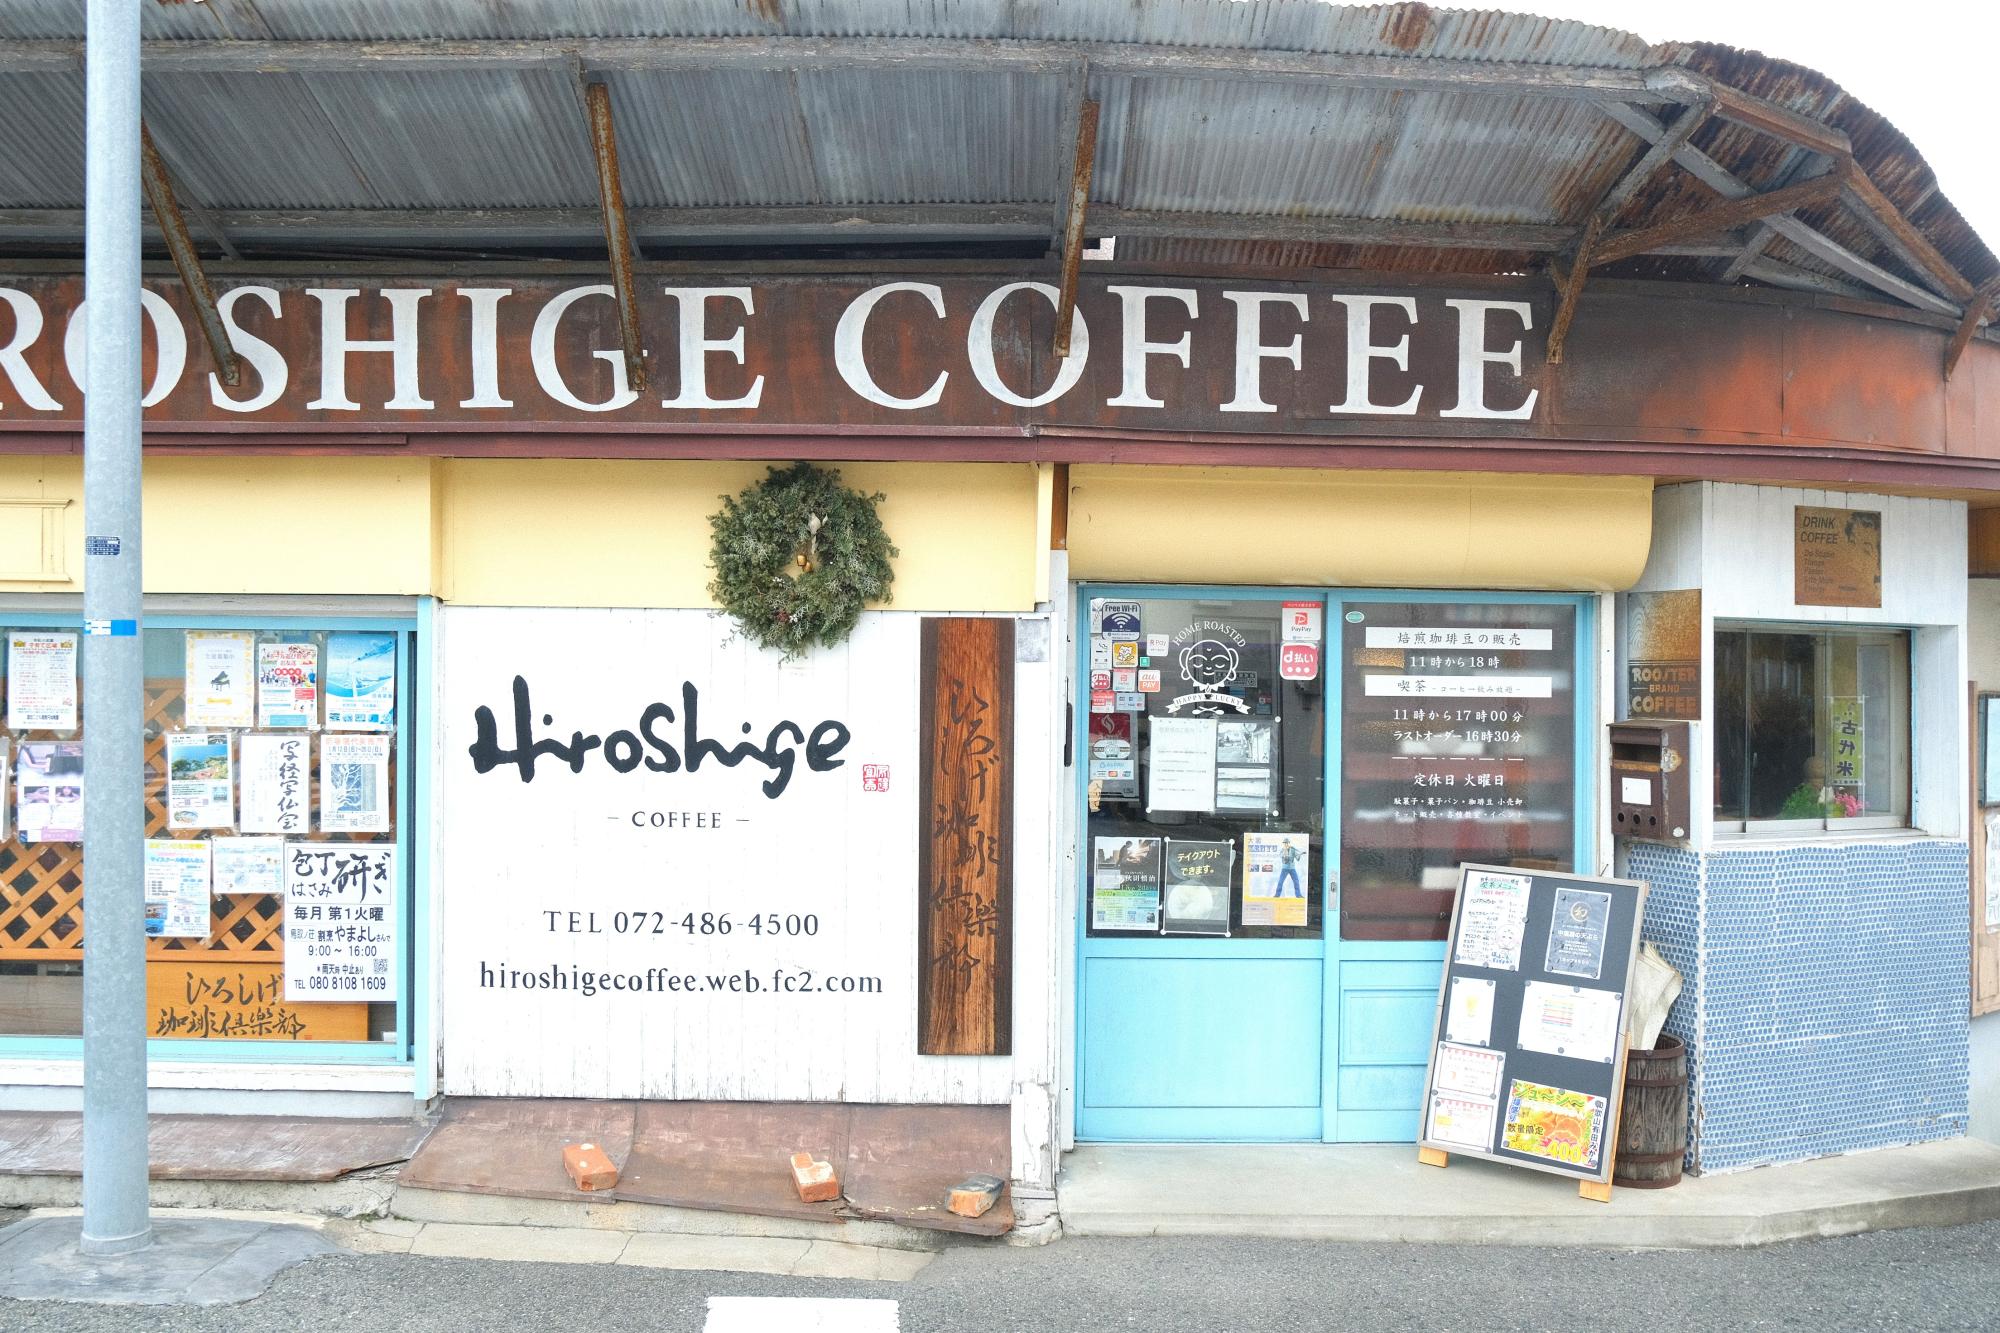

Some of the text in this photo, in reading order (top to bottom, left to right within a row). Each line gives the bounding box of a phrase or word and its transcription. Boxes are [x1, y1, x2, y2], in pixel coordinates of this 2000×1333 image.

[833, 280, 1540, 421] COFFEE
[1802, 515, 1836, 529] DRINK
[1800, 530, 1839, 545] COFFEE
[1105, 604, 1138, 613] Free Wi-Fi
[1172, 620, 1247, 648] HOME ROASTED
[1397, 631, 1522, 647] 焙煎珈琲豆の販売
[1631, 666, 1698, 682] ROOSTER
[1397, 679, 1427, 693] 喫茶
[1648, 684, 1680, 693] BRAND
[1176, 693, 1242, 706] HAPPY LUCKY
[1631, 695, 1697, 713] COFFEE
[1464, 730, 1523, 743] 16時30分
[1413, 773, 1504, 788] 定休日 火曜日
[631, 810, 723, 830] COFFEE
[1177, 849, 1221, 862] テイクアウト
[291, 882, 333, 898] はさみ
[542, 910, 820, 936] TEL 072-486-4500
[308, 945, 332, 957] 9:00
[348, 945, 378, 957] 16:00
[294, 976, 386, 991] TEL 080 8108 1609
[479, 961, 883, 997] hiroshigecoffee.web.fc2.com
[1546, 1141, 1582, 1163] 400
